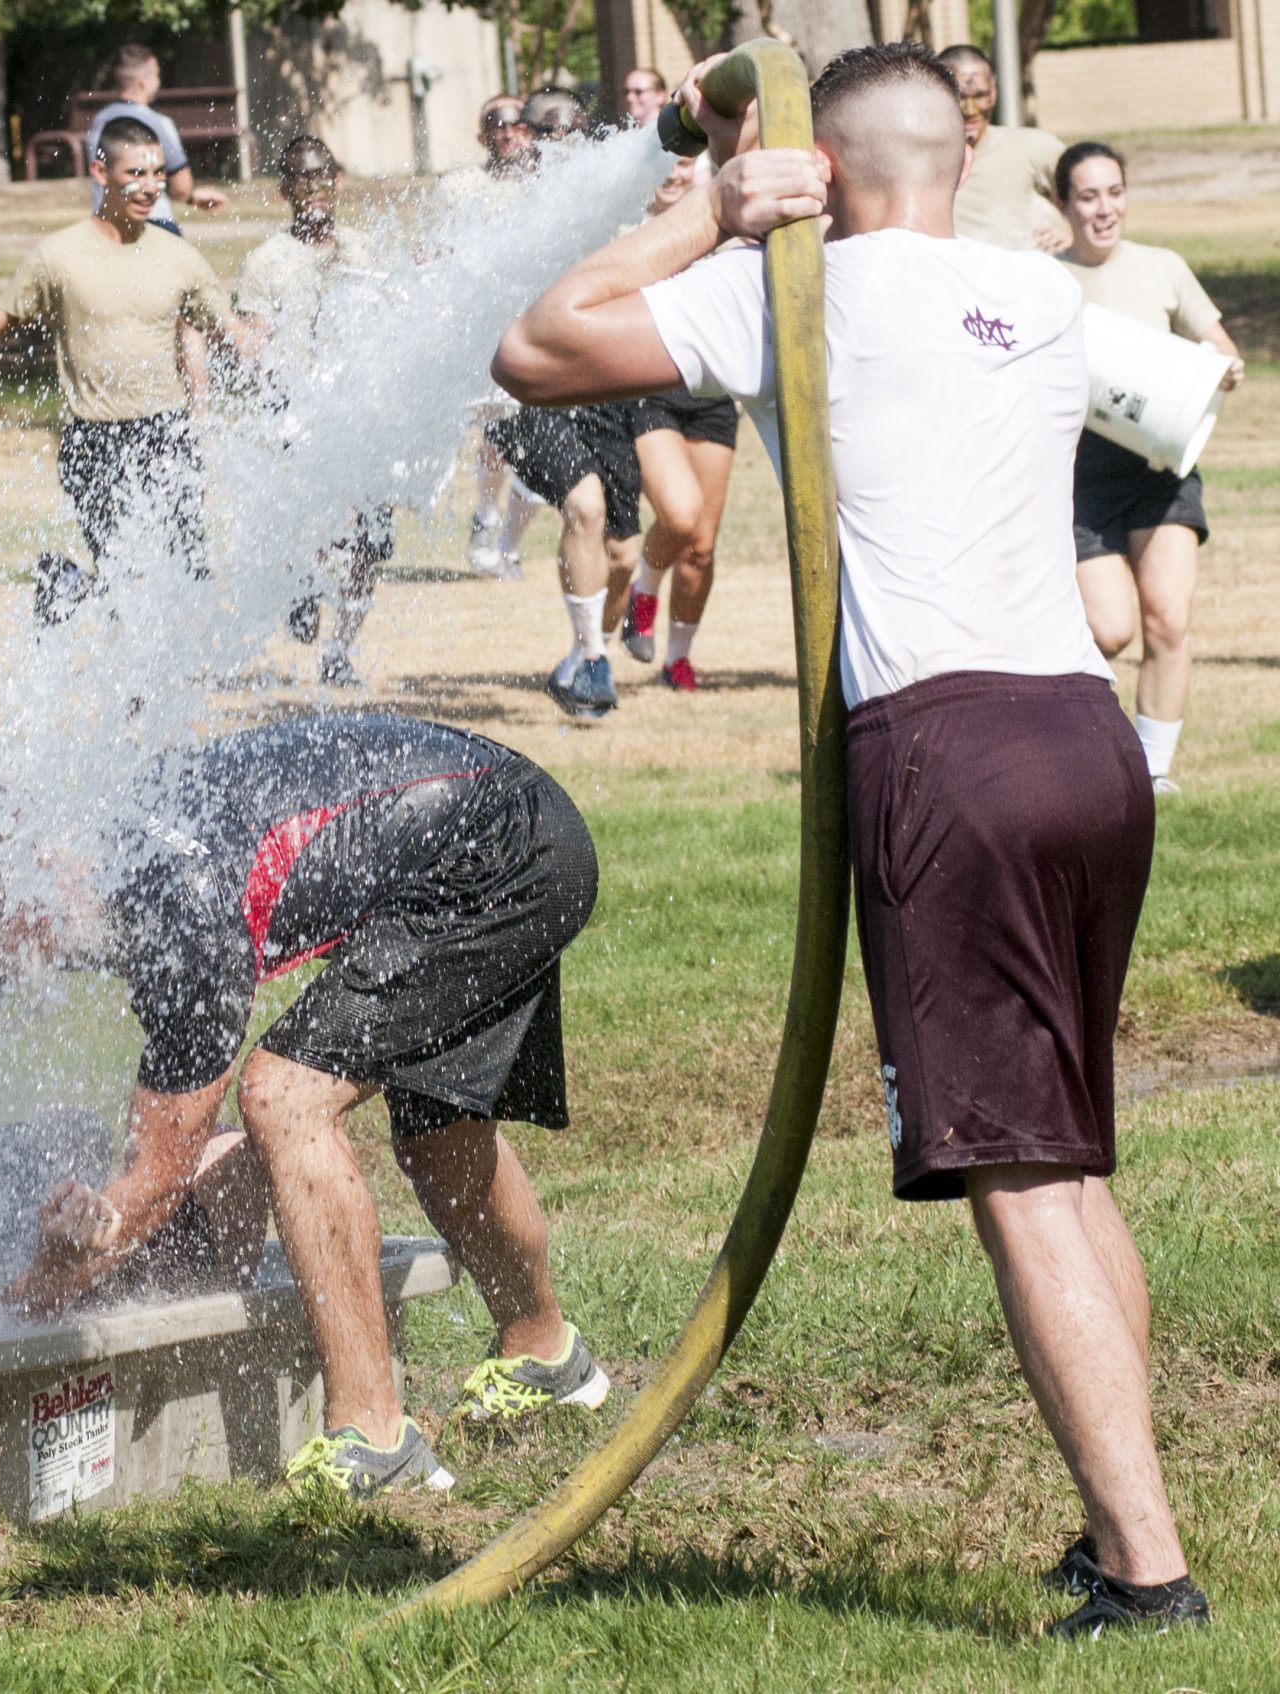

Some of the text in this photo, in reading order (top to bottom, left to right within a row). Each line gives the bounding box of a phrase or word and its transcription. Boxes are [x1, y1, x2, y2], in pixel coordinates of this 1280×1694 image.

[32, 1372, 114, 1428] Behlen
[32, 1397, 112, 1450] COUNTRY
[37, 1447, 56, 1462] Poly
[59, 1435, 83, 1453] Stock
[86, 1422, 108, 1440] Tanks
